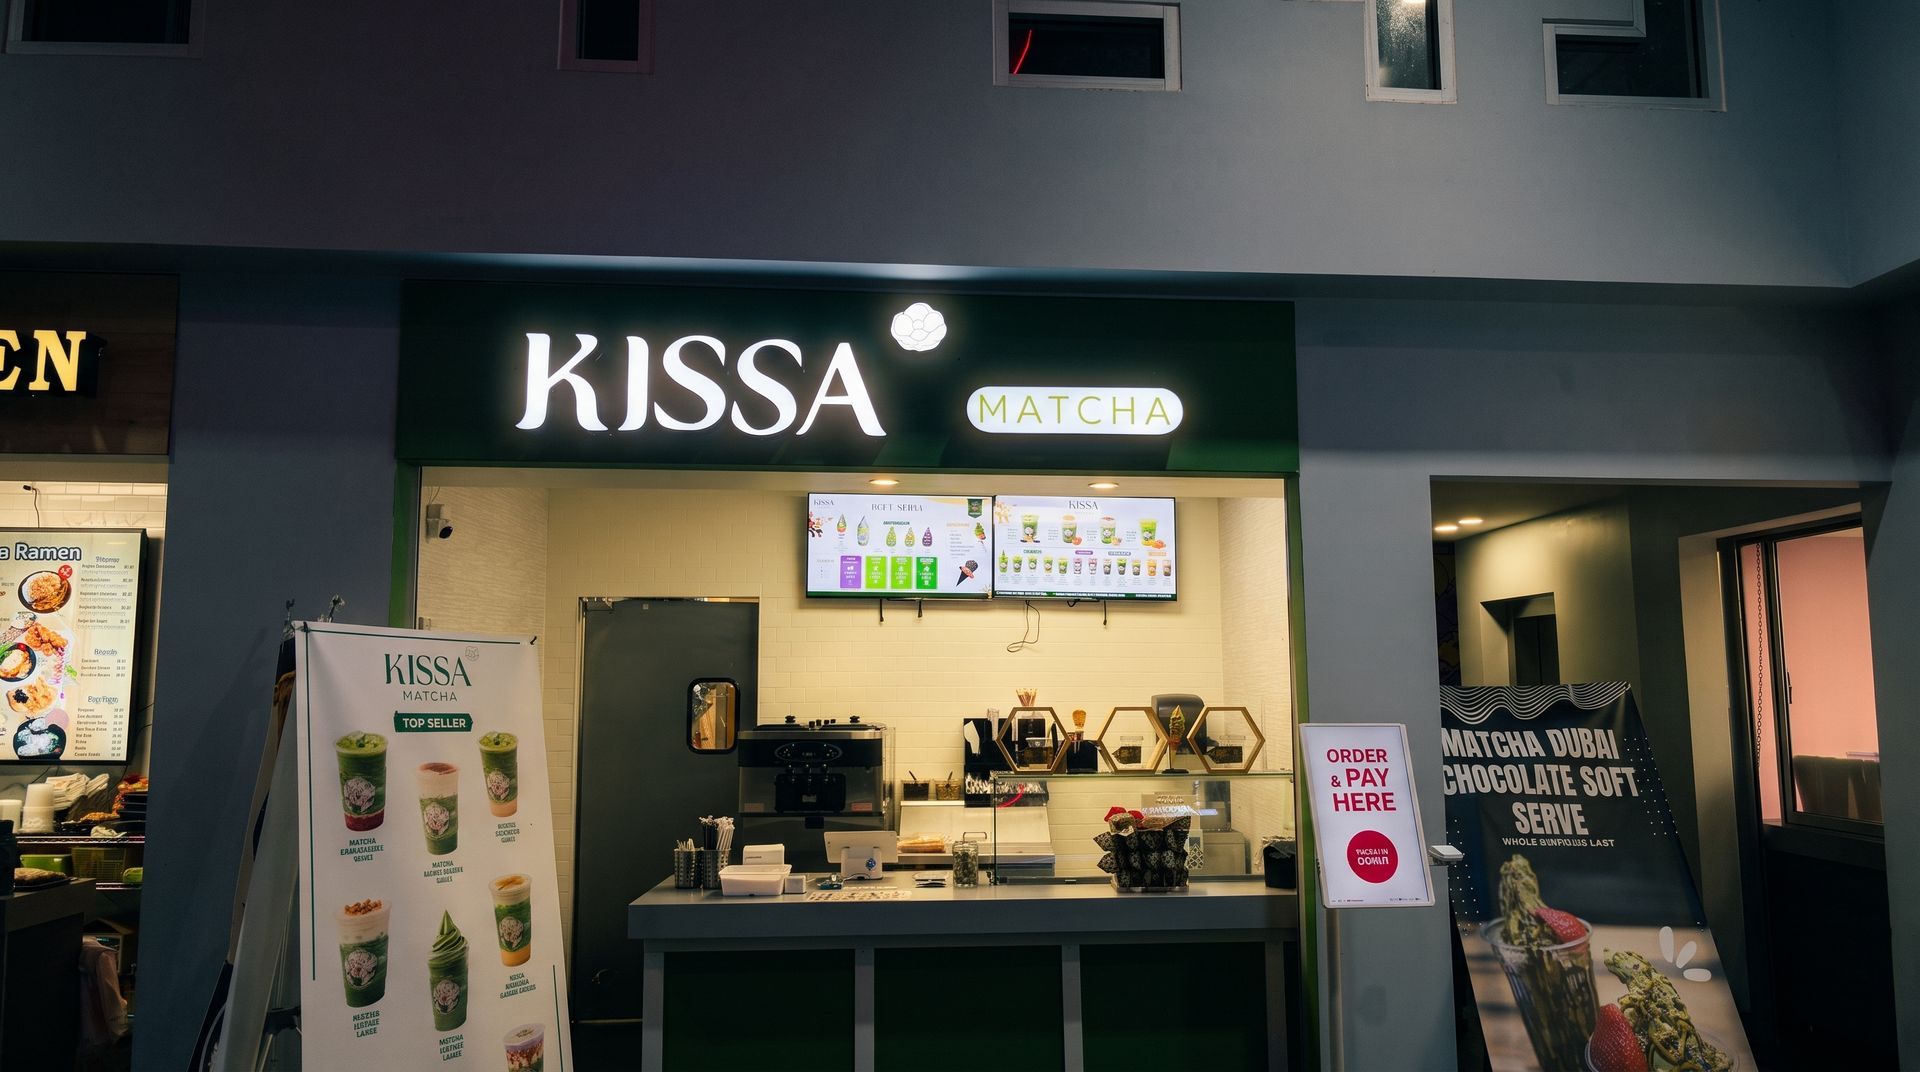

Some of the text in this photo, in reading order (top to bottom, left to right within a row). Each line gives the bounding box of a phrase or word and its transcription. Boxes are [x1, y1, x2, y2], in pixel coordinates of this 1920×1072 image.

[515, 332, 887, 437] KISSA
[977, 393, 1173, 427] MATCHA
[1068, 500, 1098, 511] KISSA
[15, 542, 82, 561] Ramen
[384, 653, 472, 686] KISSA
[403, 691, 457, 702] MATCHA
[403, 718, 466, 729] TOP SELLER
[1441, 727, 1620, 760] MATCHA DUBAI
[1327, 749, 1388, 763] ORDER
[1331, 768, 1389, 787] & PAY
[1442, 764, 1639, 797] CHOCOLATE SOFT
[1333, 792, 1396, 811] HERE
[1512, 802, 1589, 835] SERVE
[349, 838, 376, 846] MATCHA
[1502, 837, 1537, 846] WHOLE
[1590, 839, 1615, 847] LAST
